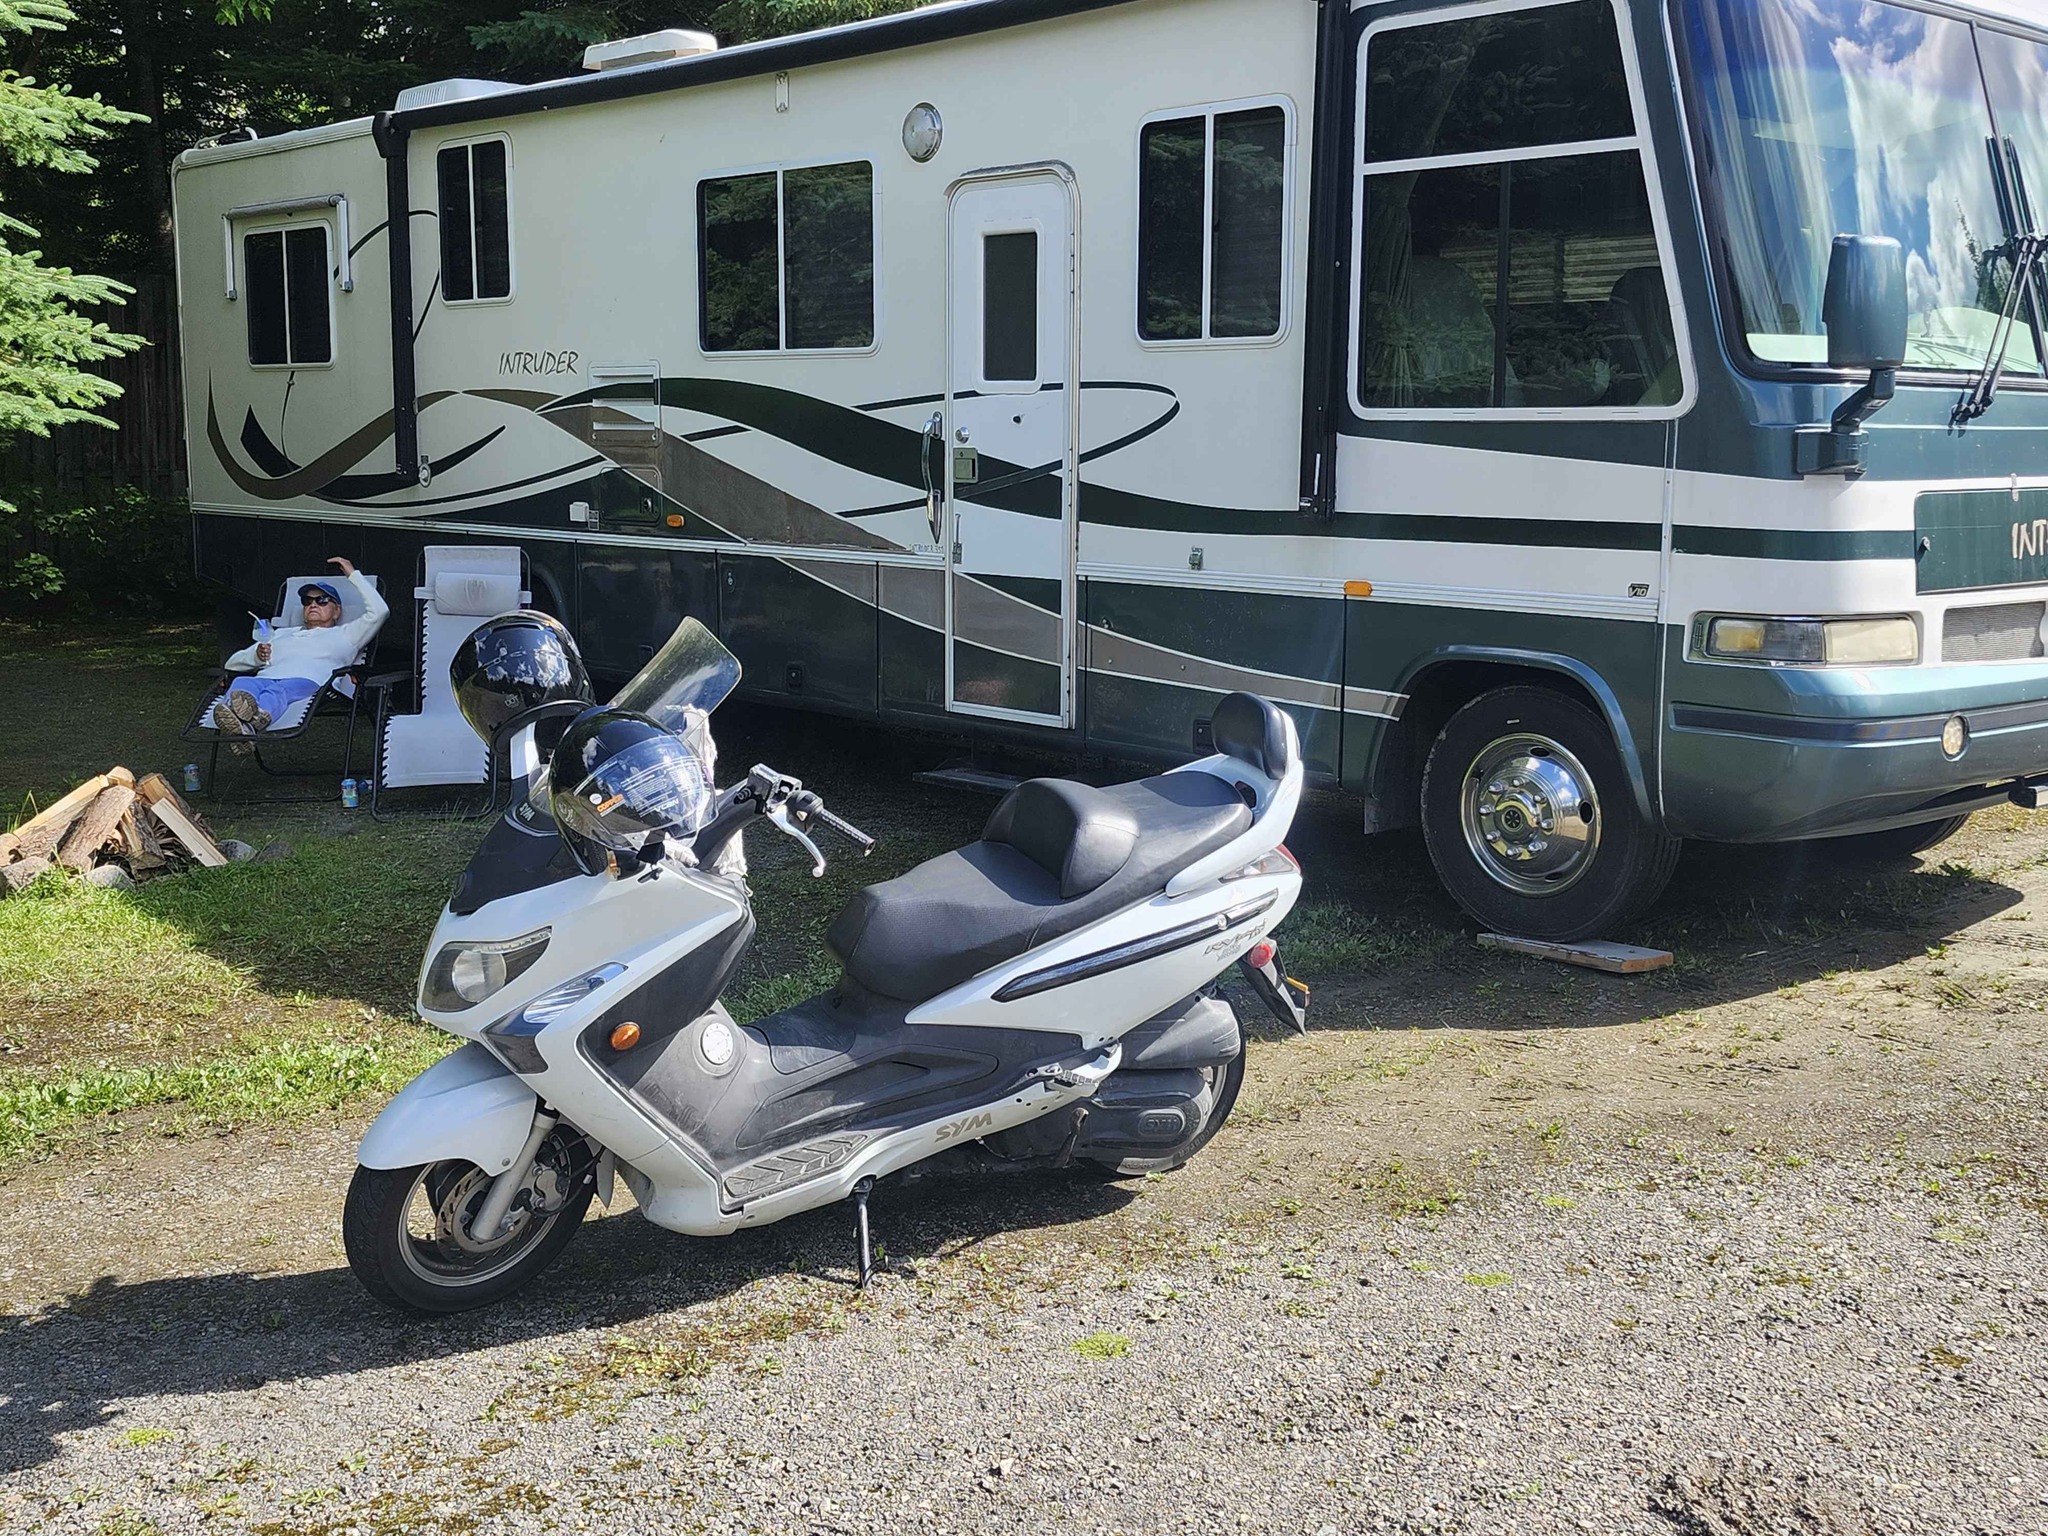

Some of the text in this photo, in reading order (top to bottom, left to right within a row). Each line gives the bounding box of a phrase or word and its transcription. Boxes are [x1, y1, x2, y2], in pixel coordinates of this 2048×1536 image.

[499, 350, 579, 376] INTRUDER
[2012, 519, 2048, 560] INT
[1629, 586, 1648, 597] V10
[519, 802, 536, 822] SYM
[934, 1112, 993, 1143] SYM
